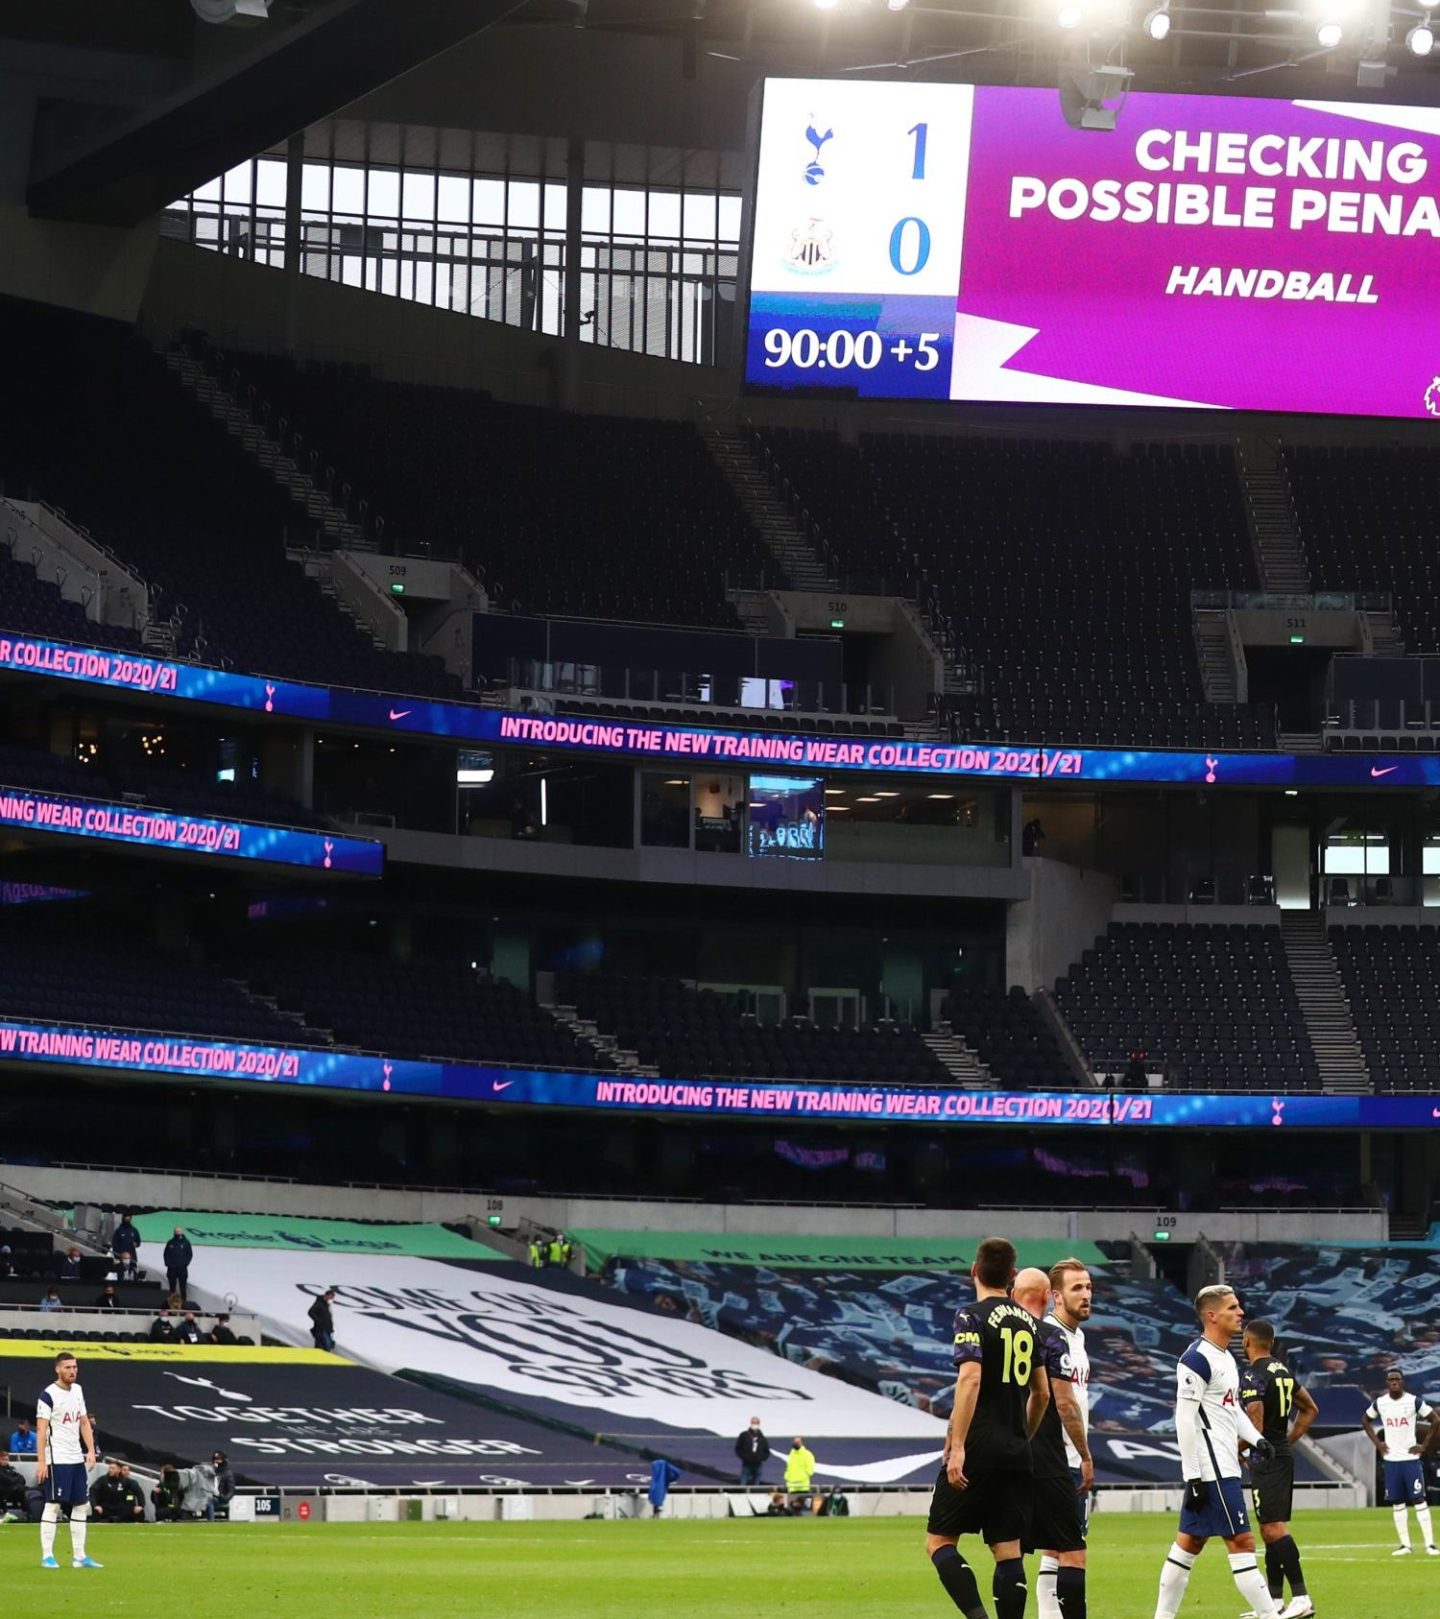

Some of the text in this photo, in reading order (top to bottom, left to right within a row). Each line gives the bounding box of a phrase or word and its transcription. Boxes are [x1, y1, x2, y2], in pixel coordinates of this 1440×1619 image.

[907, 123, 928, 179] 1
[1134, 129, 1429, 186] CHECKING
[1010, 174, 1275, 227] POSSIBLE
[889, 217, 931, 275] 0
[1167, 267, 1377, 302] HANDBALL
[764, 328, 940, 371] 90:00 +5
[389, 565, 406, 575] 509
[827, 602, 847, 611] 510
[15, 643, 109, 677] COLLECTION
[113, 660, 176, 688] 2020/21
[502, 718, 1081, 774] INTRODUCING THE NEW TRAINING WEAR COLLECTION 2020/21
[38, 803, 82, 827] WEAR
[86, 810, 175, 839] COLLECTION
[179, 823, 239, 849] 2020/21
[19, 1032, 92, 1057] TRAINING
[96, 1039, 141, 1061] WEAR
[144, 1043, 235, 1070] COLLECTION
[237, 1052, 298, 1076] 2020/21
[598, 1083, 1151, 1120] INTRODUCING THE NEW TRAINING WEAR COLLECTION 2020/21
[1156, 1217, 1177, 1227] 109
[954, 1332, 981, 1344] CM
[1000, 1327, 1034, 1387] 18
[132, 1404, 446, 1424] TOGETHER
[1275, 1377, 1294, 1417] 13
[1386, 1416, 1409, 1428] AIA
[229, 1437, 544, 1455] STRONGER
[1413, 1478, 1422, 1492] 6
[256, 1499, 272, 1511] 105
